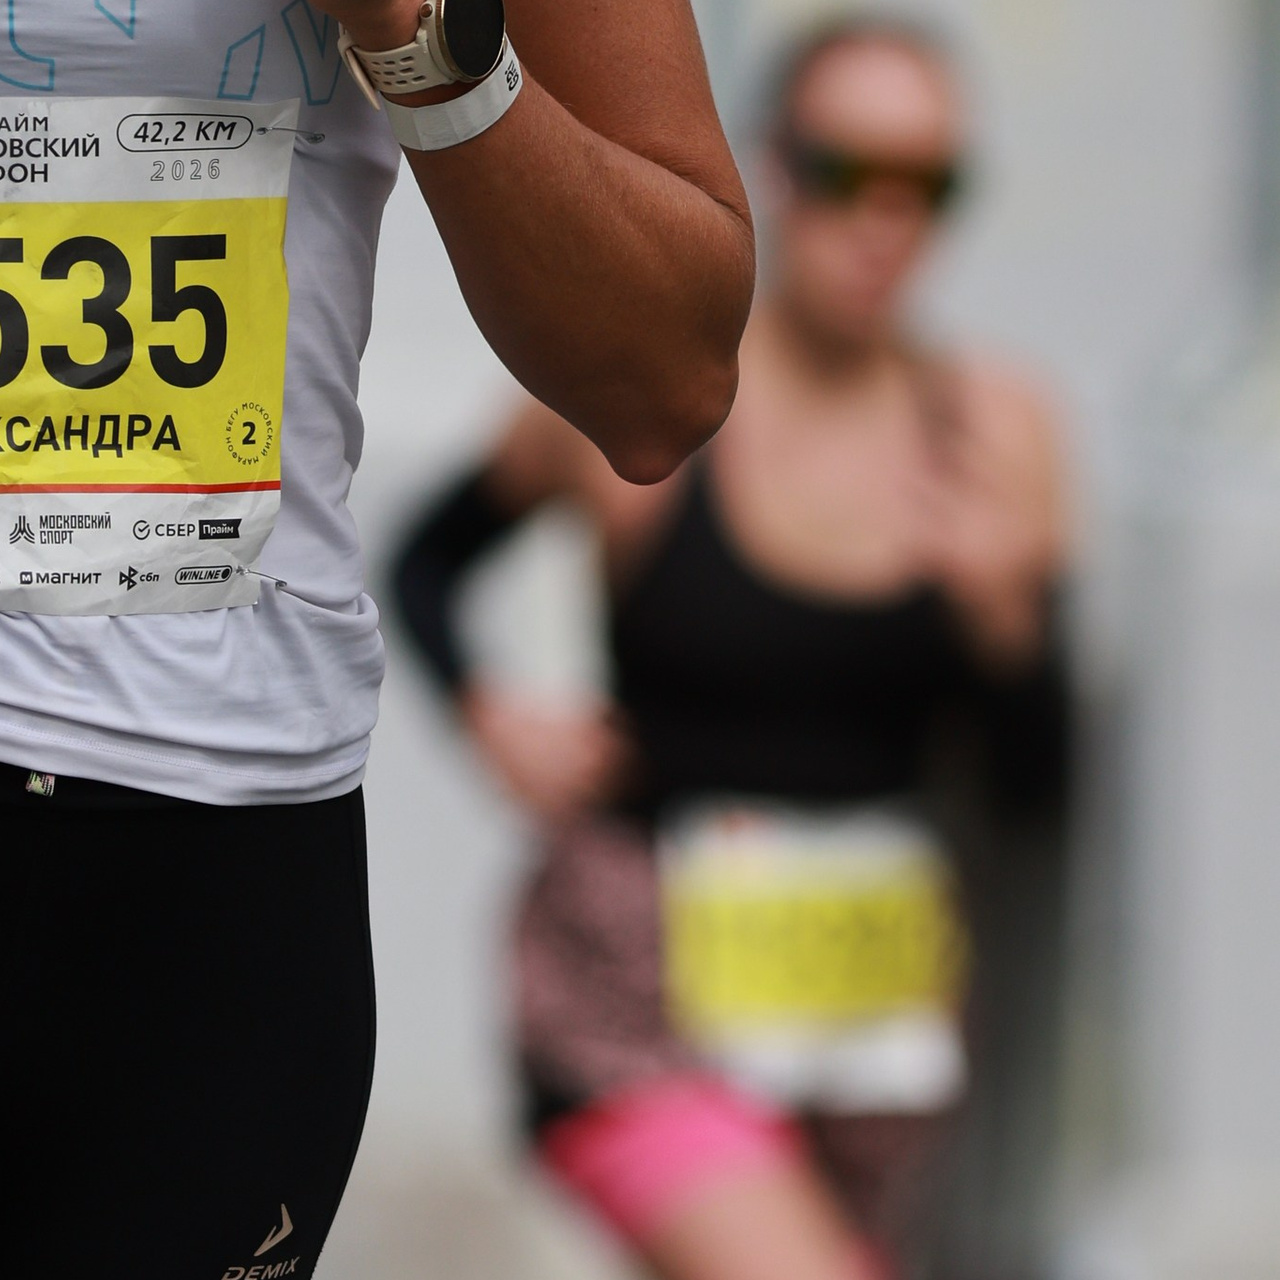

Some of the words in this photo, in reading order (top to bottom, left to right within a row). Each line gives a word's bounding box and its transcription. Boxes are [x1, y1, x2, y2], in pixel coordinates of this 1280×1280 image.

[133, 120, 186, 146] 42,2
[150, 158, 221, 182] 2026
[226, 408, 239, 432] БЕГУ
[242, 402, 273, 456] МОСКОВСКИЙ
[242, 421, 256, 445] 2
[226, 436, 259, 465] МАРАФОН
[40, 511, 111, 529] МОСКОВСКИЙ
[155, 523, 196, 537] СБЕР
[202, 523, 234, 536] Прайм
[40, 530, 74, 544] СПОРТ
[179, 570, 221, 581] WINLINE
